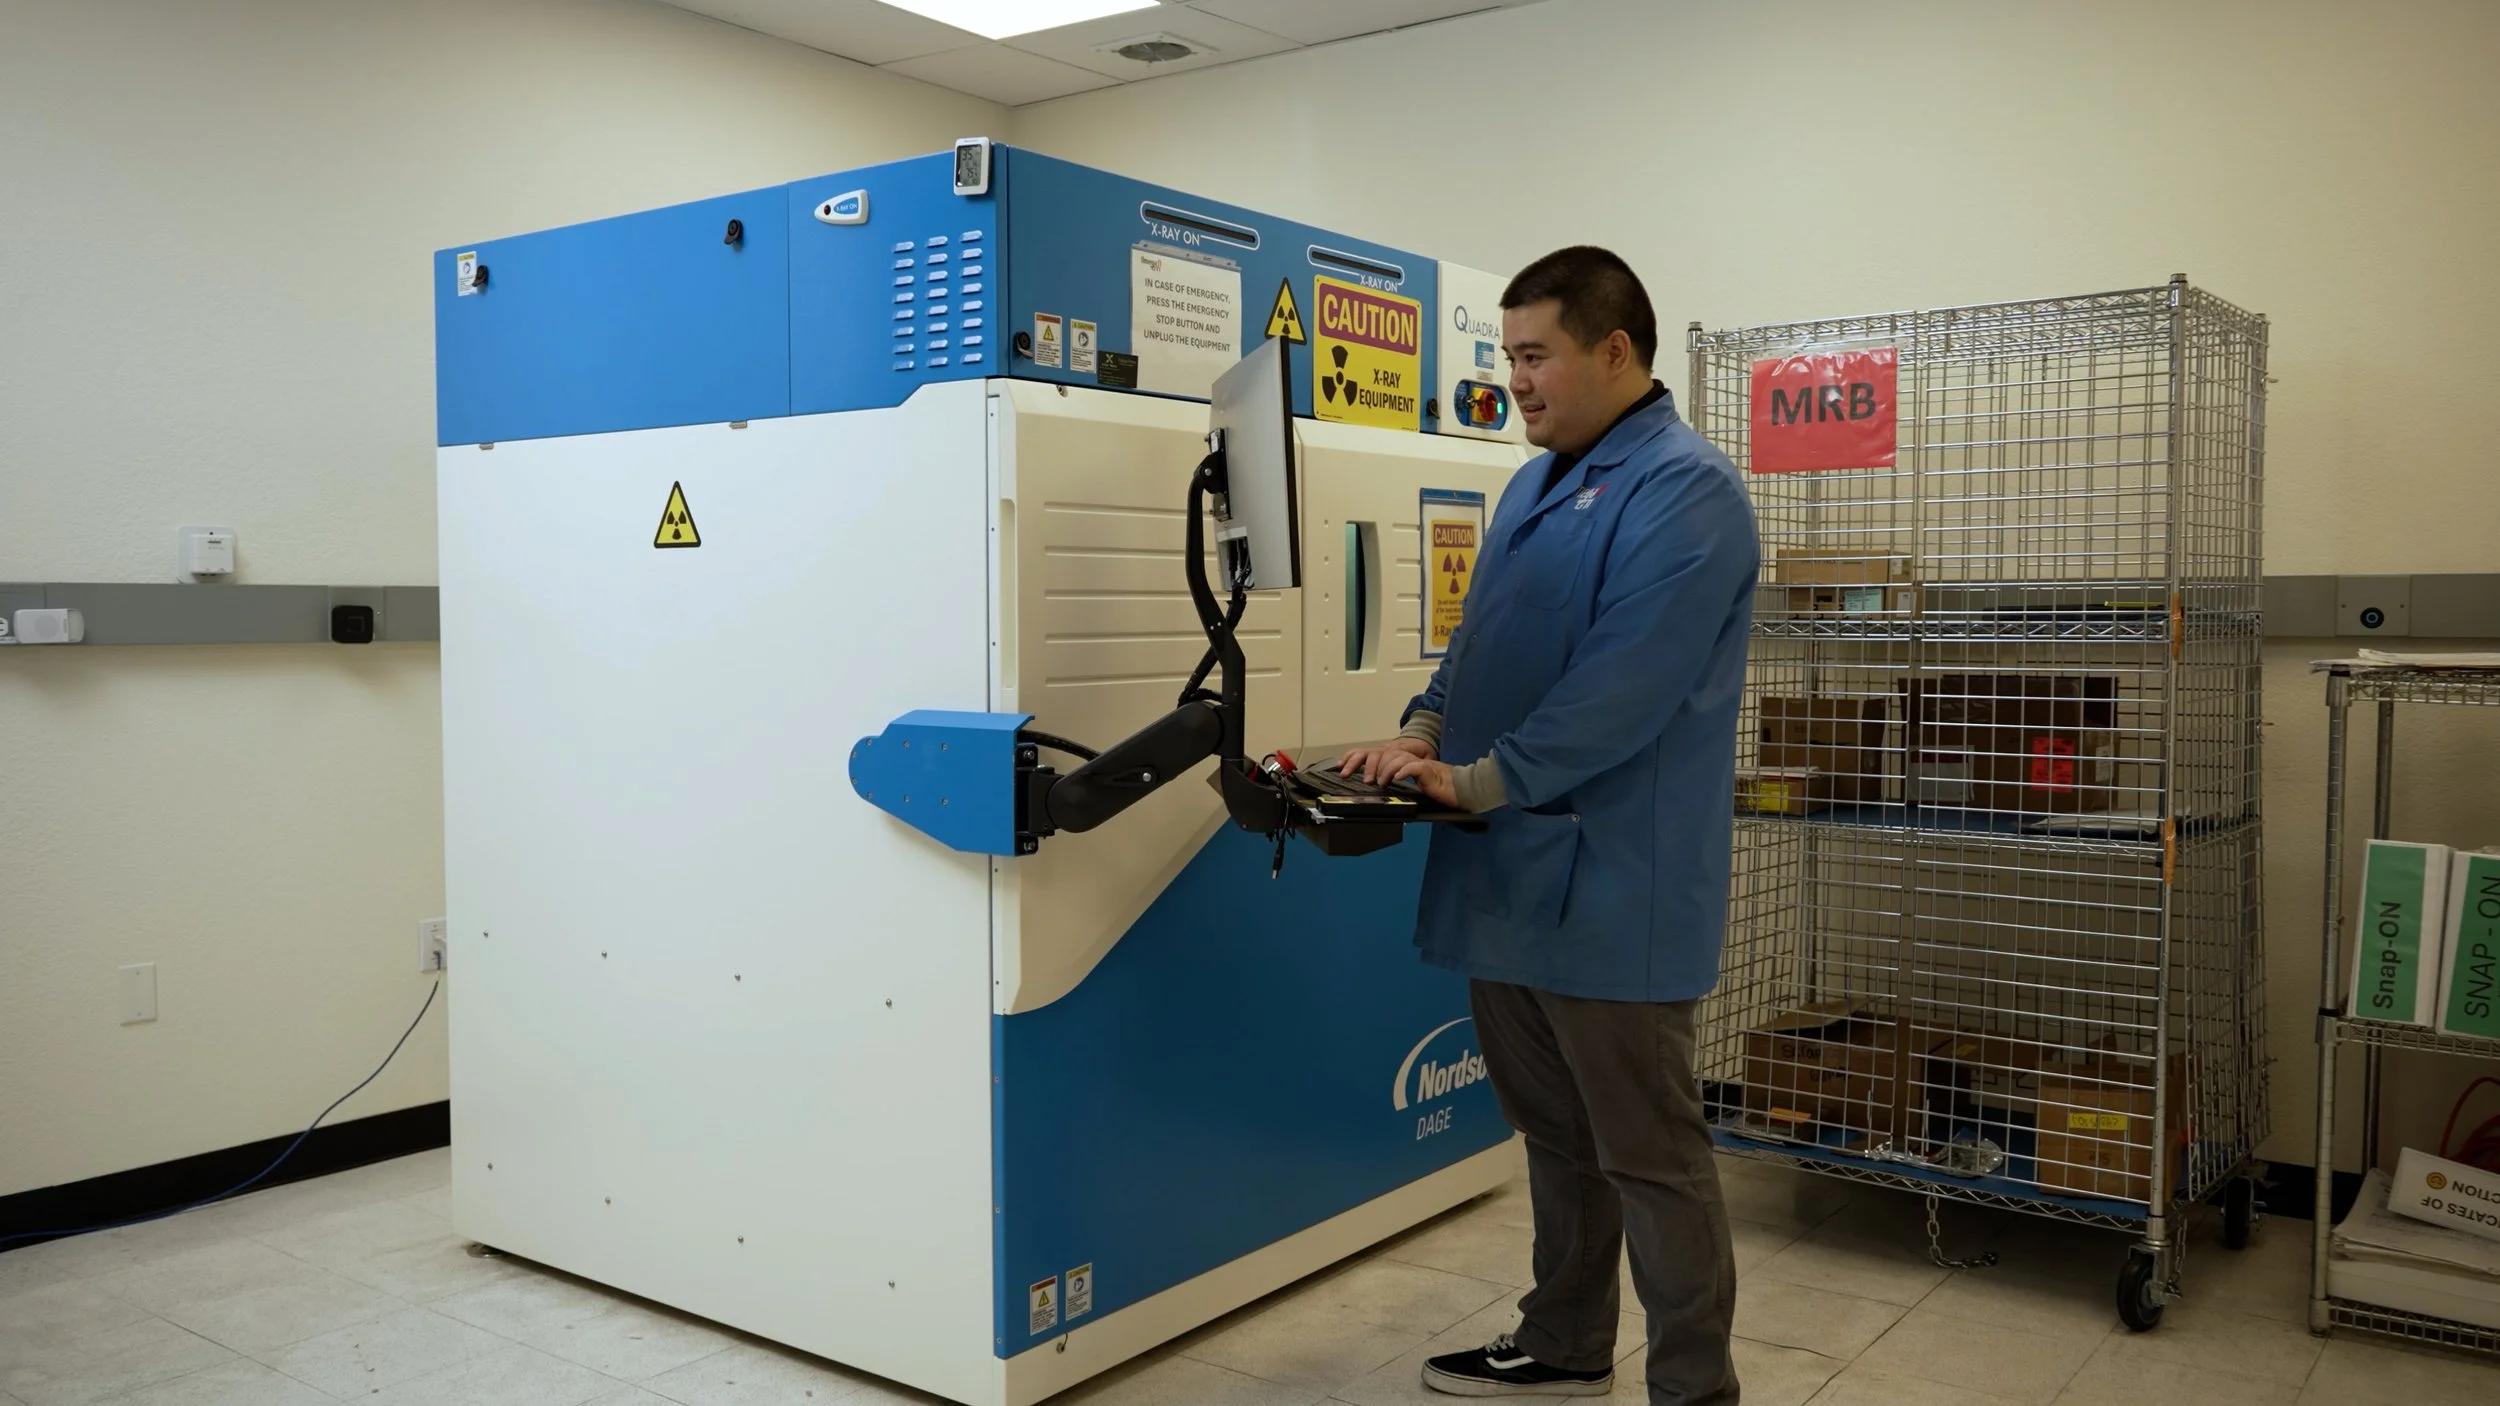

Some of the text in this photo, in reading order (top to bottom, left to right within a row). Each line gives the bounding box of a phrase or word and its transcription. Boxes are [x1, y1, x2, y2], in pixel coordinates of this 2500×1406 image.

[1151, 222, 1200, 246] X-RAY ON
[1145, 278, 1153, 288] IN
[1154, 280, 1174, 292] CASE
[1175, 284, 1185, 293] OF
[1360, 274, 1398, 293] X-RAY ON
[1146, 295, 1230, 319] PRESS THE EMERGENCY
[1156, 314, 1220, 334] STOP BUTTON AND
[1323, 292, 1415, 348] CAUTION
[1144, 329, 1231, 352] UNPLUG THE EQUIPMENT
[1373, 367, 1401, 389] X-RAY
[1359, 387, 1415, 415] EQUIPMENT
[1771, 382, 1875, 426] MRB
[1434, 526, 1474, 546] CAUTION
[2477, 876, 2500, 919] ON
[2373, 901, 2402, 1009] Snap-ON
[2464, 943, 2497, 1019] SNAP
[1416, 1106, 1453, 1141] DAGE
[2452, 1180, 2500, 1204] CTION
[2420, 1196, 2444, 1213] OF
